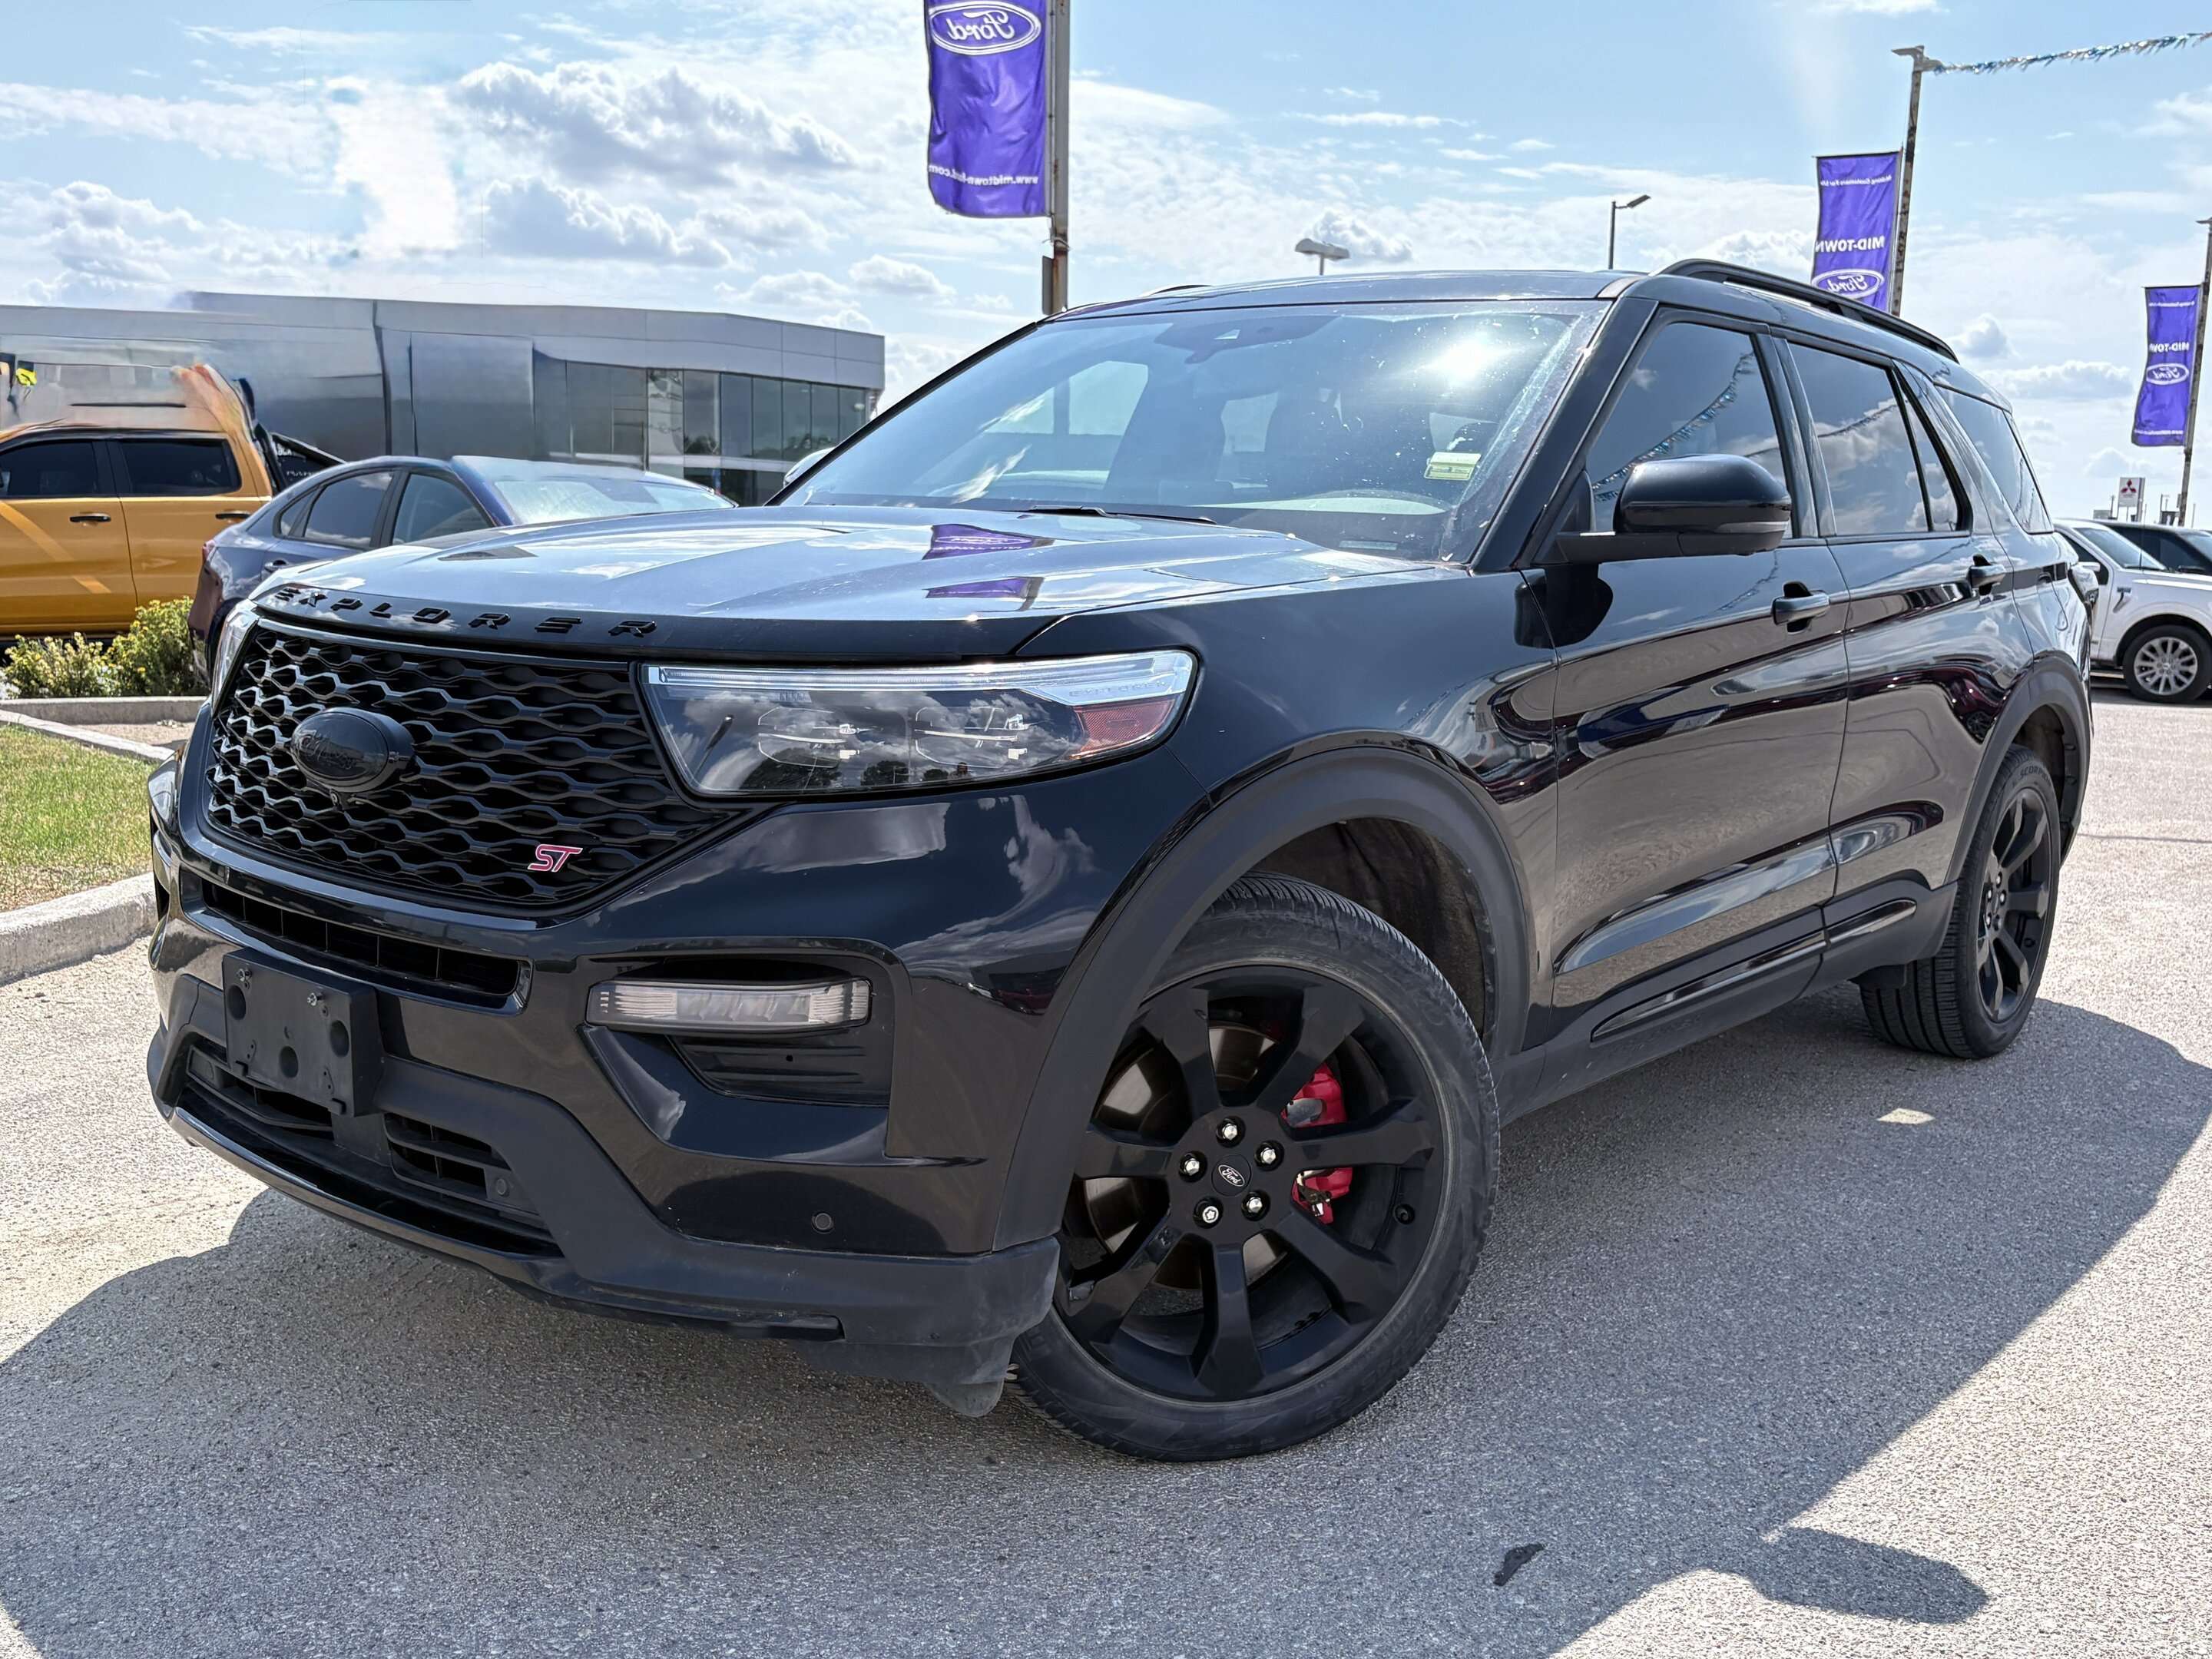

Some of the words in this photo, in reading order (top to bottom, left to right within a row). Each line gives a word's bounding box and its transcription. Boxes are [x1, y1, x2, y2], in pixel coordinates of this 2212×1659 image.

[275, 588, 657, 638] EXPLORER
[527, 843, 584, 873] ST
[1222, 1168, 1241, 1184] Ford
